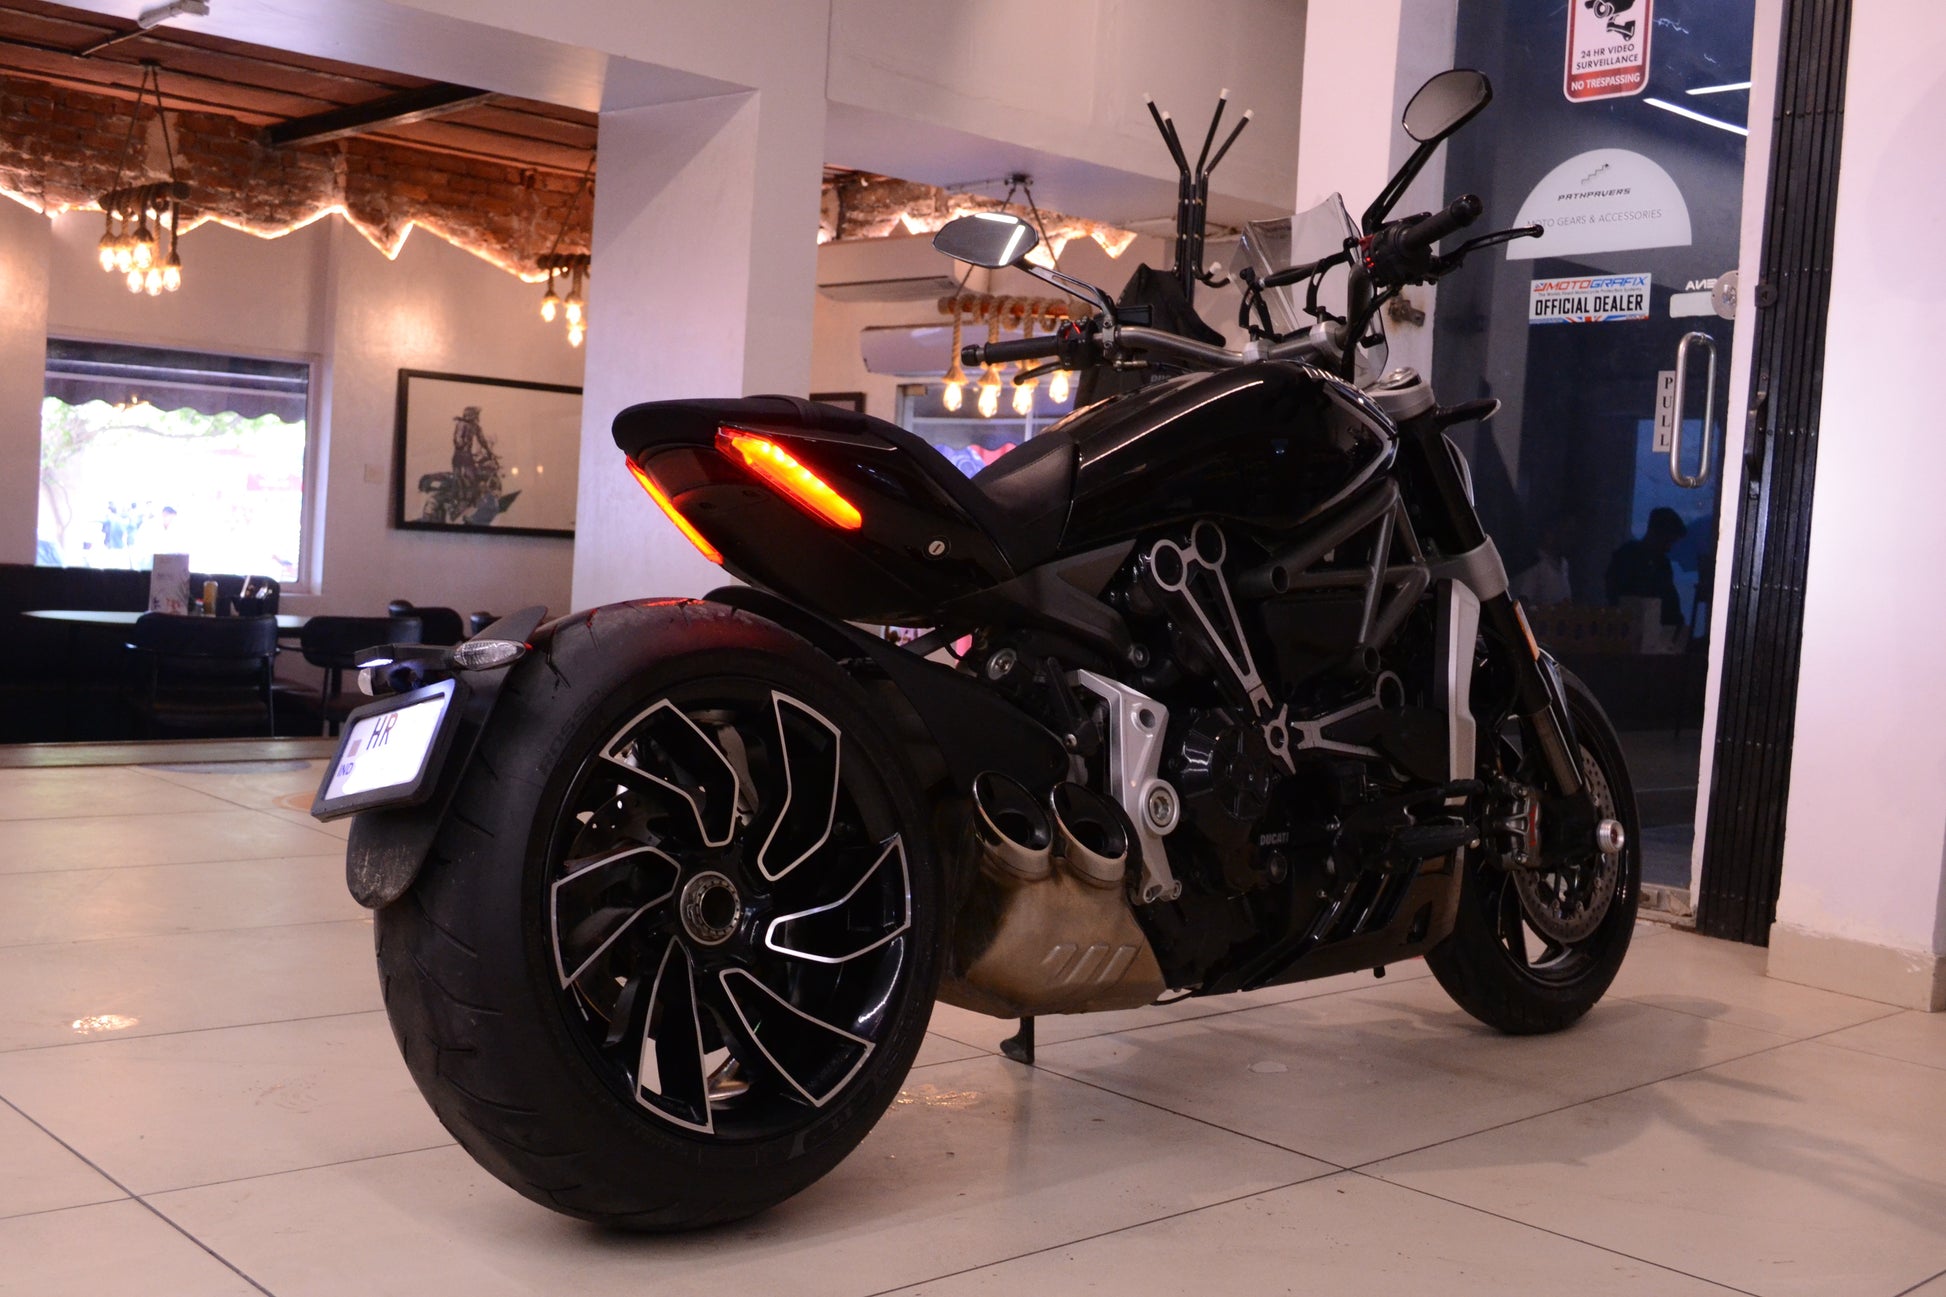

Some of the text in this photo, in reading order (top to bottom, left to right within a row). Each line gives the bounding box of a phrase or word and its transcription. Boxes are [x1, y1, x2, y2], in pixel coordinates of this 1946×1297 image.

[1581, 43, 1635, 59] 24 HR VIDEO
[1576, 54, 1639, 70] SURVEILLANCE
[1571, 72, 1640, 91] NO TRESPASSING
[1557, 215, 1587, 227] GEARS
[1589, 215, 1596, 224] &
[1599, 209, 1662, 223] ACCESSORIES
[1541, 277, 1648, 291] MOTOGRAFIX
[1535, 294, 1643, 316] OFFICIAL DEALER
[1660, 377, 1673, 446] PULL
[366, 712, 398, 750] HR
[337, 762, 354, 777] IND
[1260, 832, 1290, 846] DUCATI
